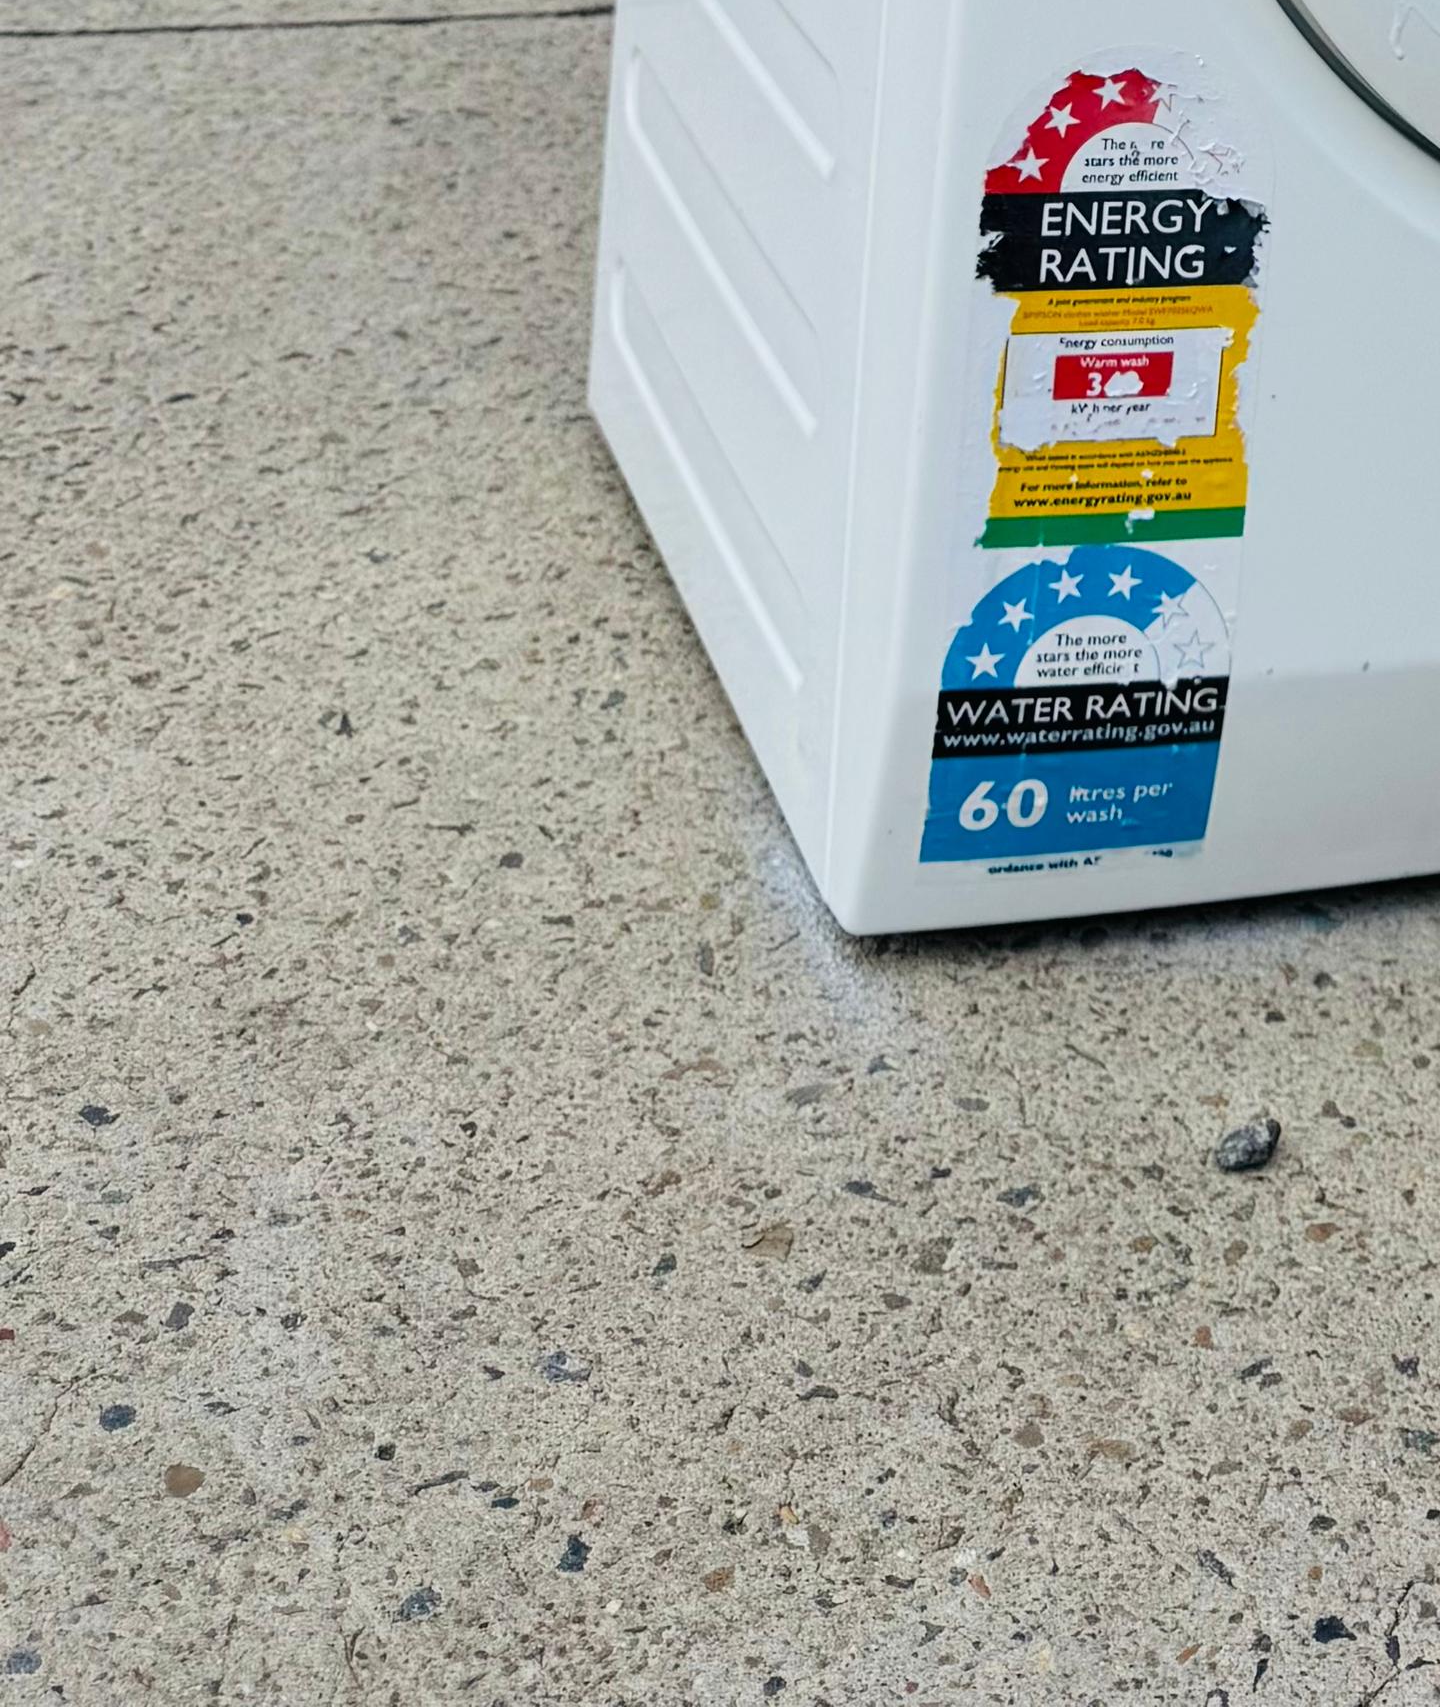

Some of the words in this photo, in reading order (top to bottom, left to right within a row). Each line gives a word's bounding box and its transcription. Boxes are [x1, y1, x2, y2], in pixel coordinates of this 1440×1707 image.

[1101, 138, 1126, 151] The
[1120, 154, 1140, 167] the
[1144, 154, 1178, 167] more
[1082, 171, 1125, 185] energy
[1129, 169, 1178, 183] efficient
[1041, 198, 1214, 238] ENERGY
[1039, 244, 1206, 284] RATING
[1101, 334, 1174, 348] consumption
[1080, 356, 1118, 369] Warm
[1120, 354, 1150, 367] wash
[1021, 481, 1039, 492] For
[1043, 480, 1072, 491] more
[1146, 477, 1172, 487] refer
[1175, 476, 1187, 487] to
[1013, 491, 1192, 508] www.energyrating.gov.au
[1056, 633, 1083, 646] The
[1087, 633, 1127, 646] more
[1037, 651, 1070, 663] stars
[1075, 648, 1099, 662] the
[1103, 648, 1143, 660] more
[1037, 666, 1080, 678] water
[946, 695, 1073, 727] WATER
[1085, 688, 1219, 719] RATING
[943, 718, 1216, 749] www.waterrating.gov.au
[1068, 785, 1126, 804] litres
[1133, 781, 1174, 802] per
[958, 778, 1049, 832] 60
[1066, 804, 1124, 825] wash
